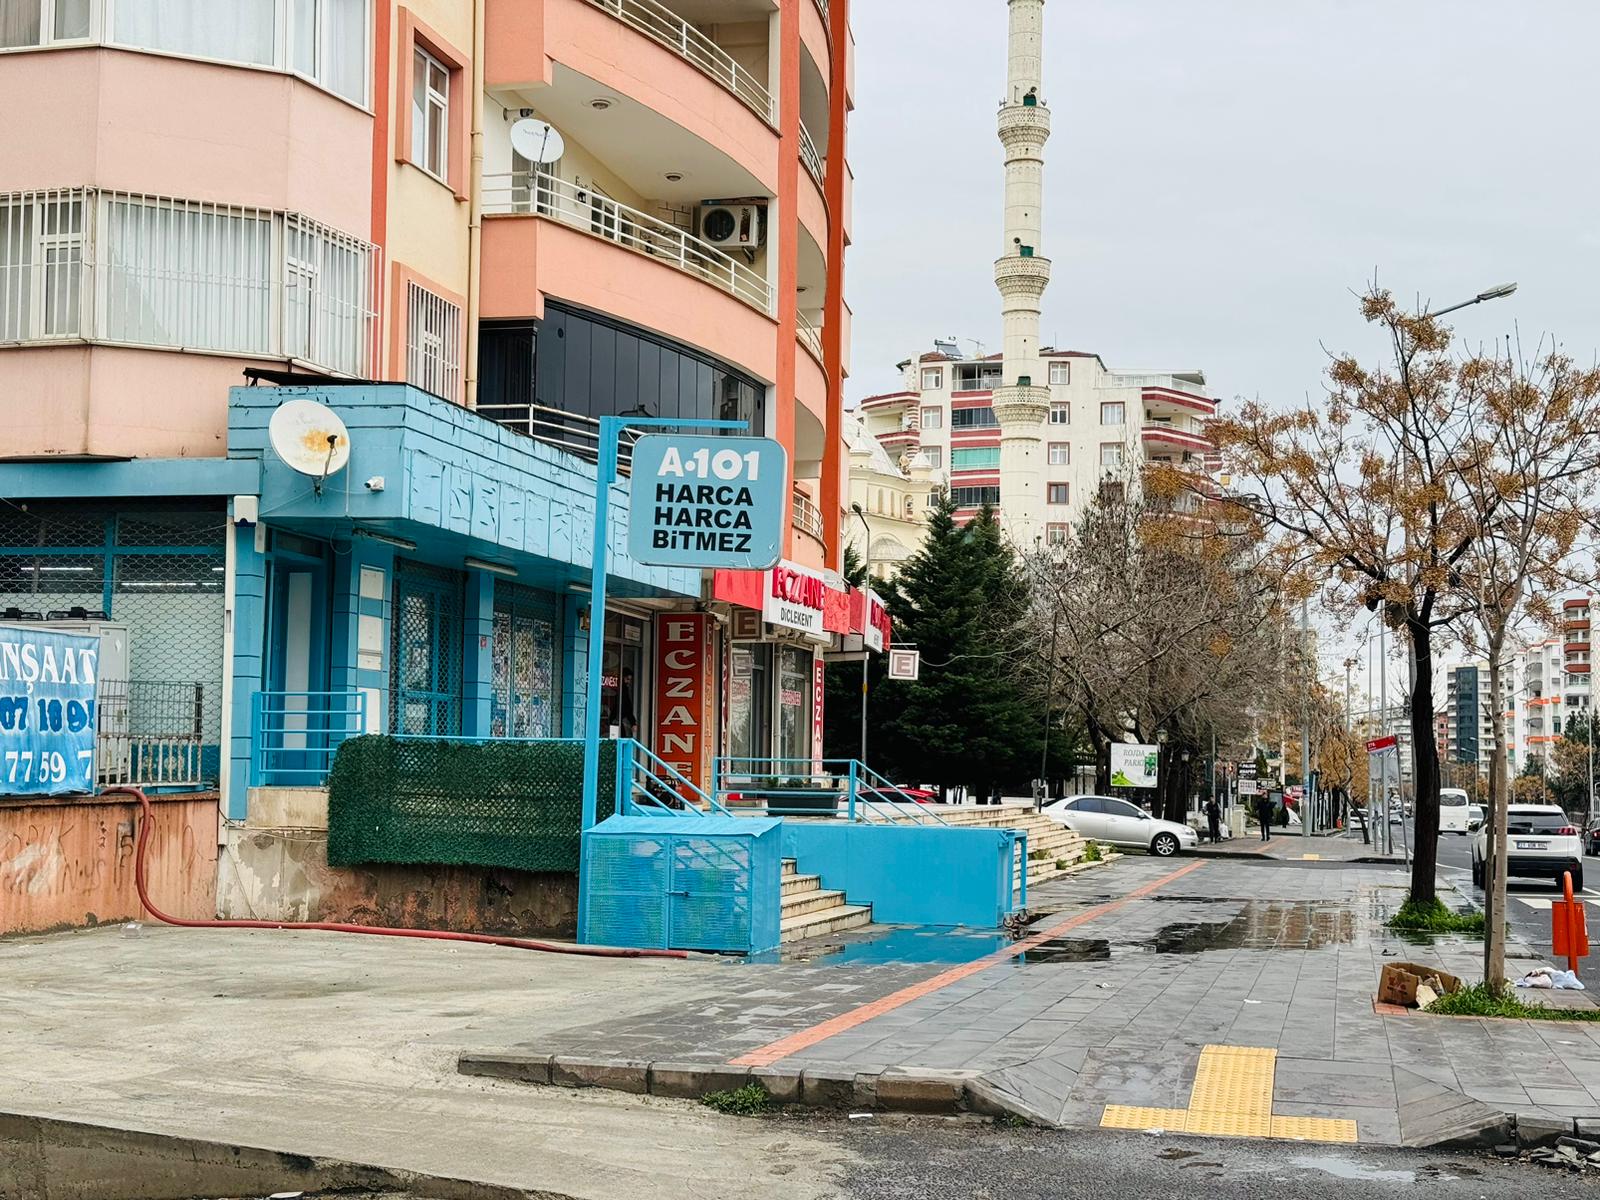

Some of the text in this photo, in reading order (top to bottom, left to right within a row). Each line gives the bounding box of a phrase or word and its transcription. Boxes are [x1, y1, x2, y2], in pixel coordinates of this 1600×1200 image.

[655, 483, 754, 506] HARCA
[654, 506, 752, 529] HARCA
[652, 529, 752, 553] BiTMEZ
[772, 566, 825, 611] ECZANE
[0, 642, 97, 695] NŞAAT
[896, 656, 911, 673] E
[660, 621, 698, 783] ECZANE
